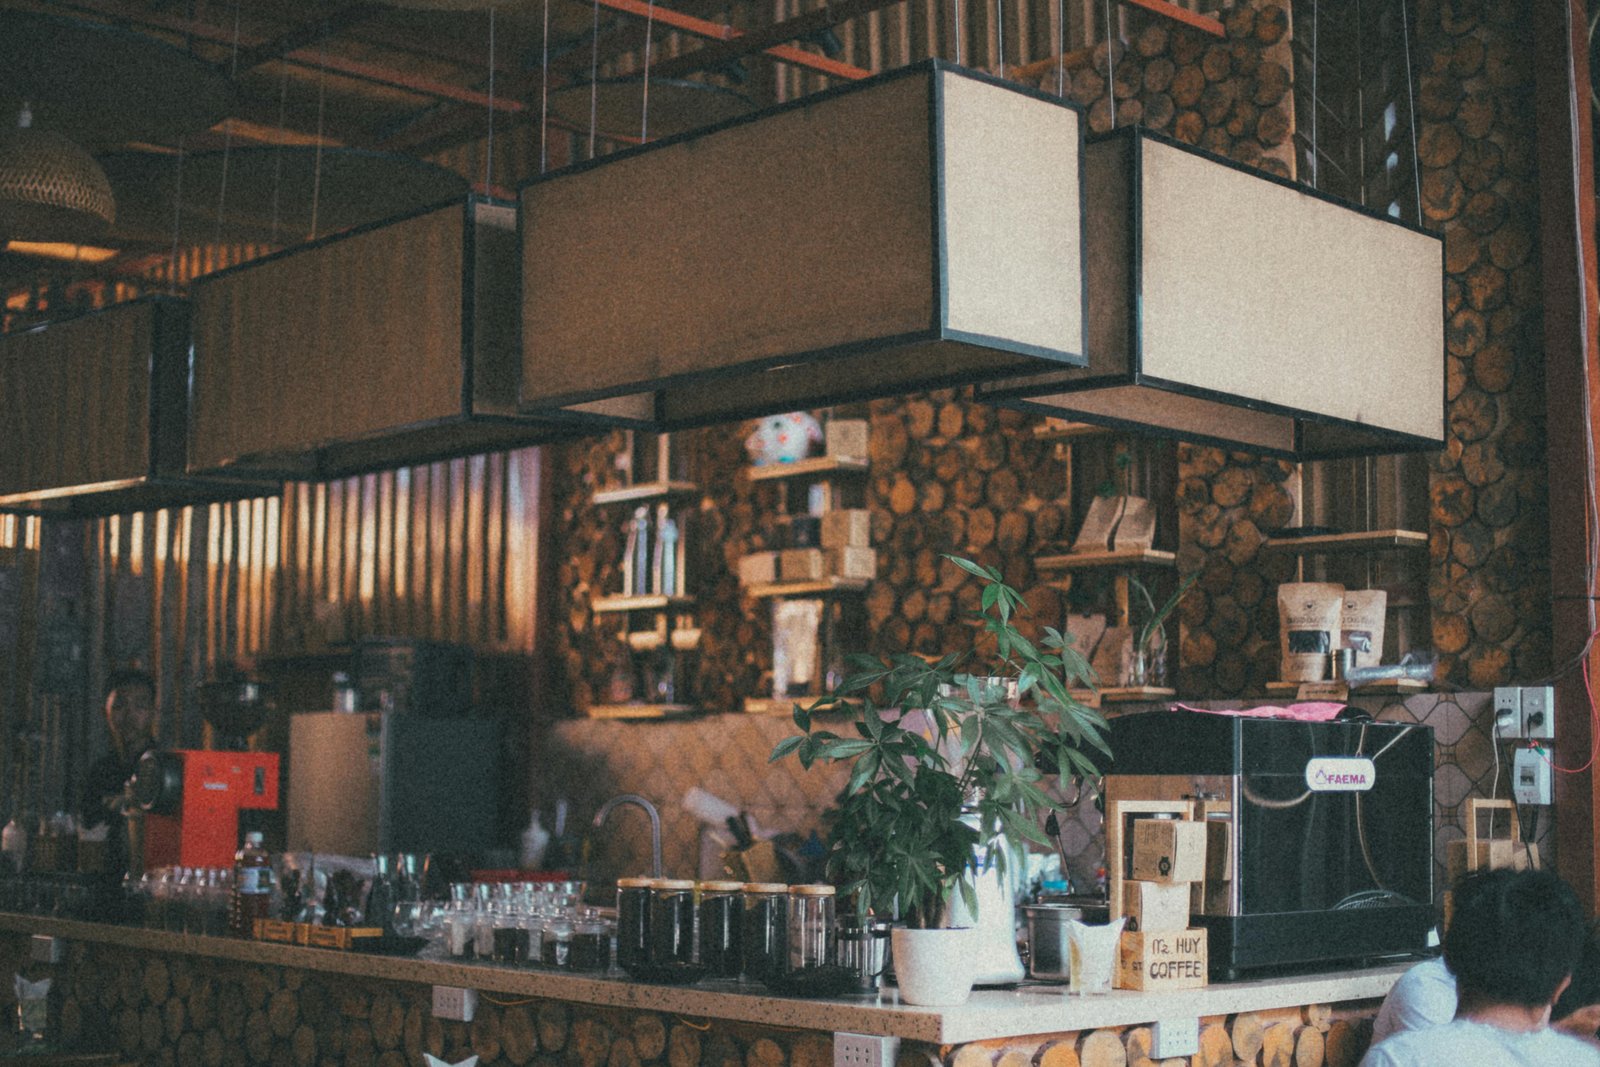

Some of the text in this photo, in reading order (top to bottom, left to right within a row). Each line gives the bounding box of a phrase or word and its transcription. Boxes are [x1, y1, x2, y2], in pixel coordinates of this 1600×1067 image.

[1327, 774, 1366, 785] FAEMA
[1176, 937, 1201, 954] HUY
[1149, 960, 1201, 979] COFFEE
